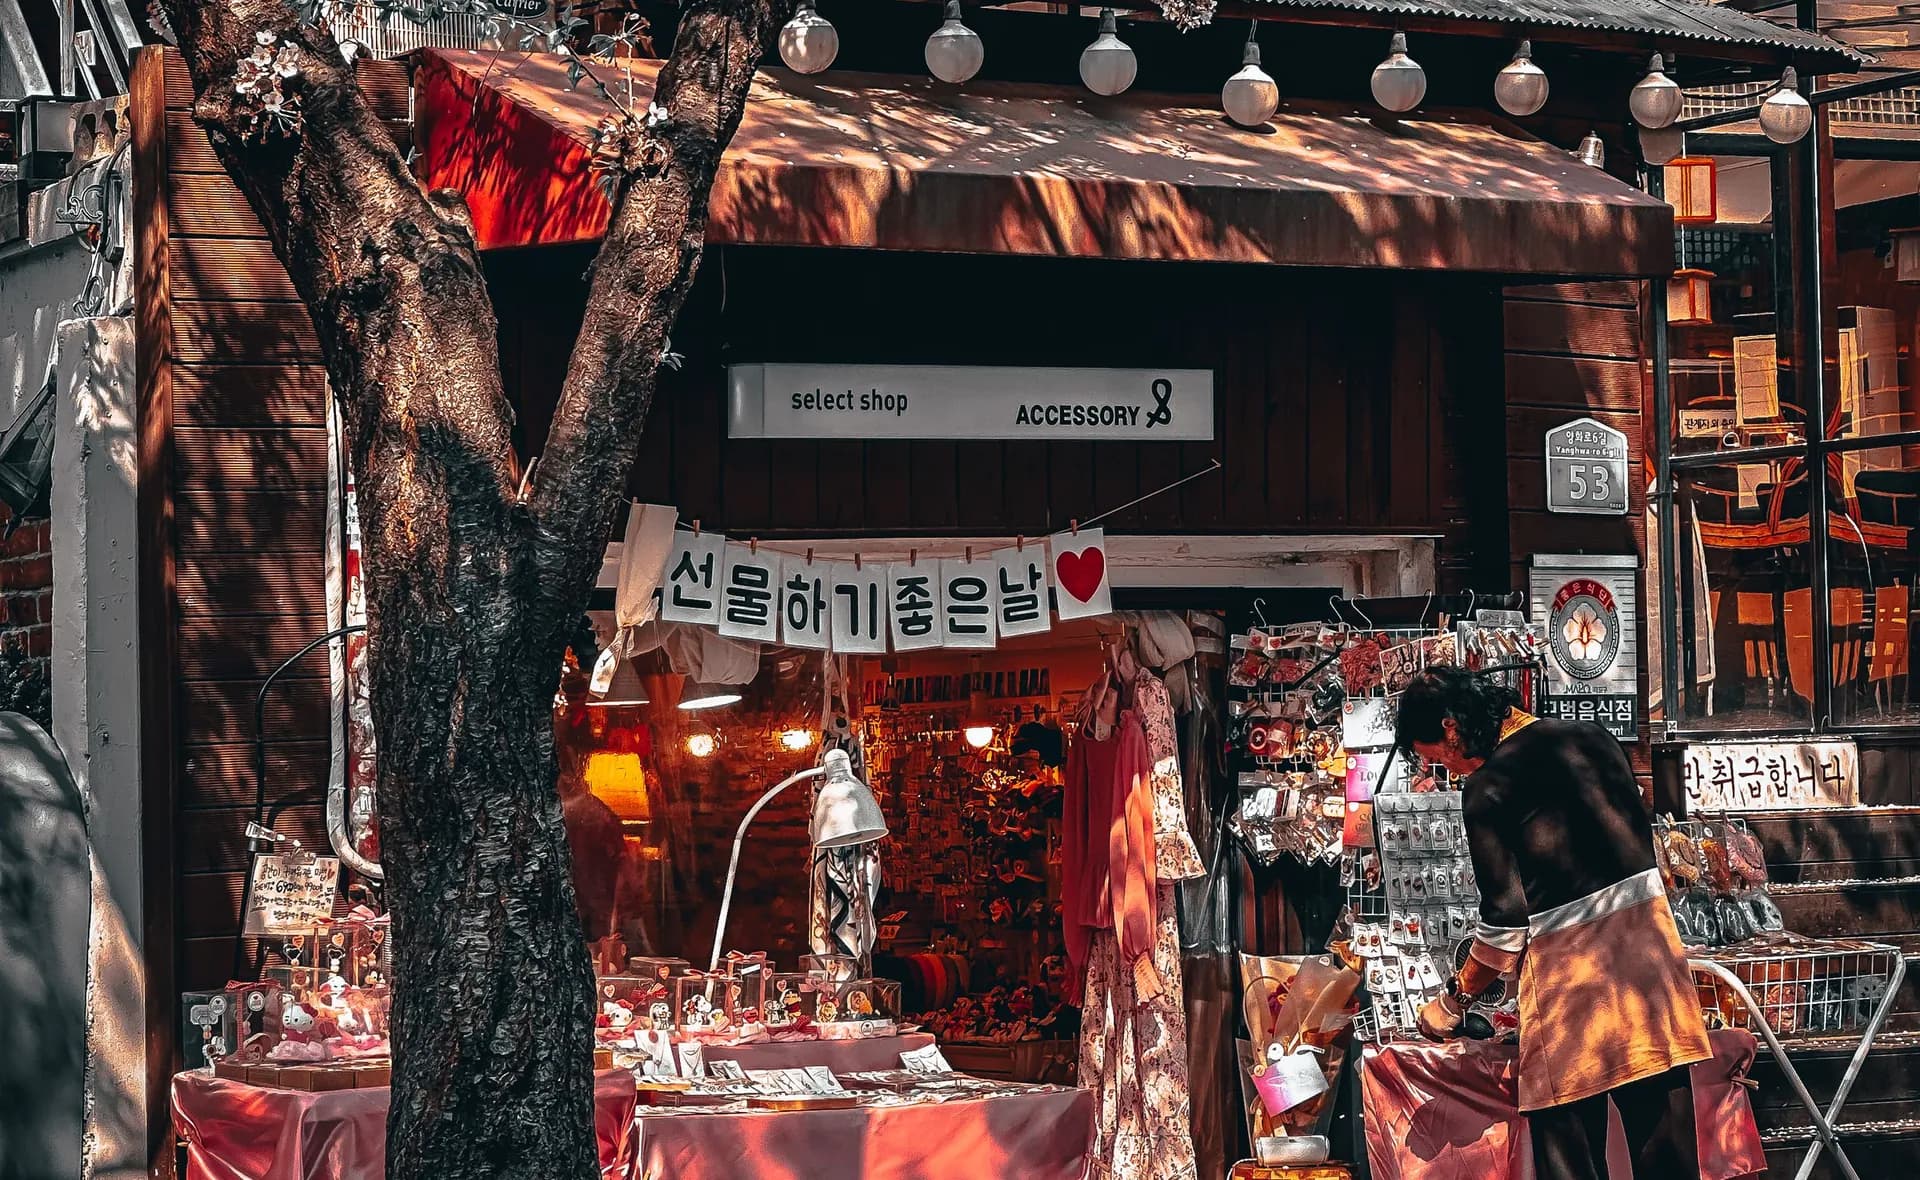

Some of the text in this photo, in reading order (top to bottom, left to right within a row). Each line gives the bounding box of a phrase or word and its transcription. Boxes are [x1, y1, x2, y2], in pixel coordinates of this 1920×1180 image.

[791, 388, 908, 417] select shop
[1015, 404, 1140, 427] ACCESSORY
[1570, 465, 1609, 501] 53
